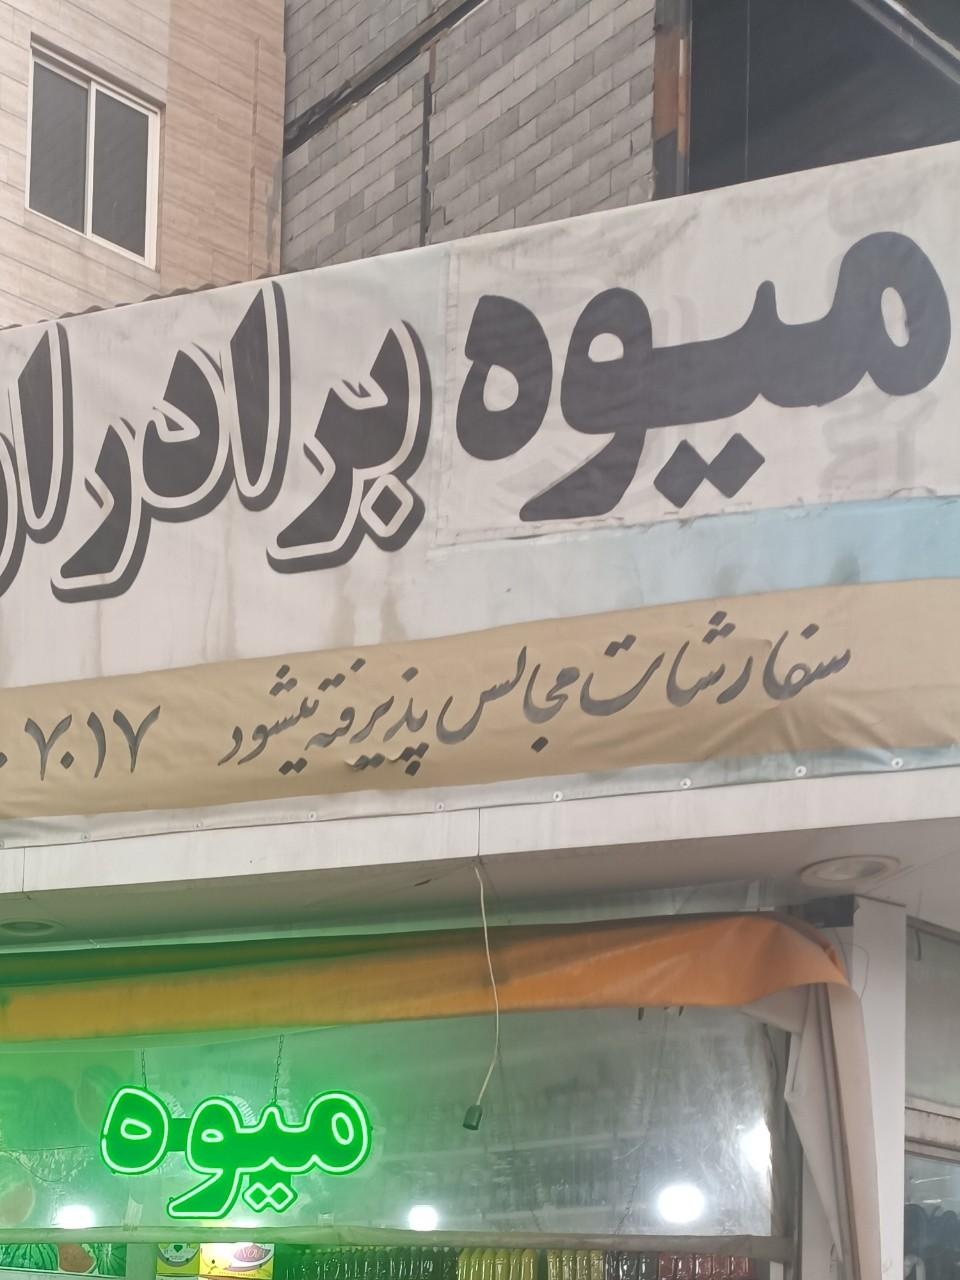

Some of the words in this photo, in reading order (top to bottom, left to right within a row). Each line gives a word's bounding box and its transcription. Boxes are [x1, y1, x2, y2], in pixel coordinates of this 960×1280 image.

[454, 230, 951, 523] میوه
[306, 658, 429, 777] پذیرفته
[436, 646, 580, 752] مجالس
[580, 610, 851, 716] سفارشات
[98, 1086, 372, 1219] میوه
